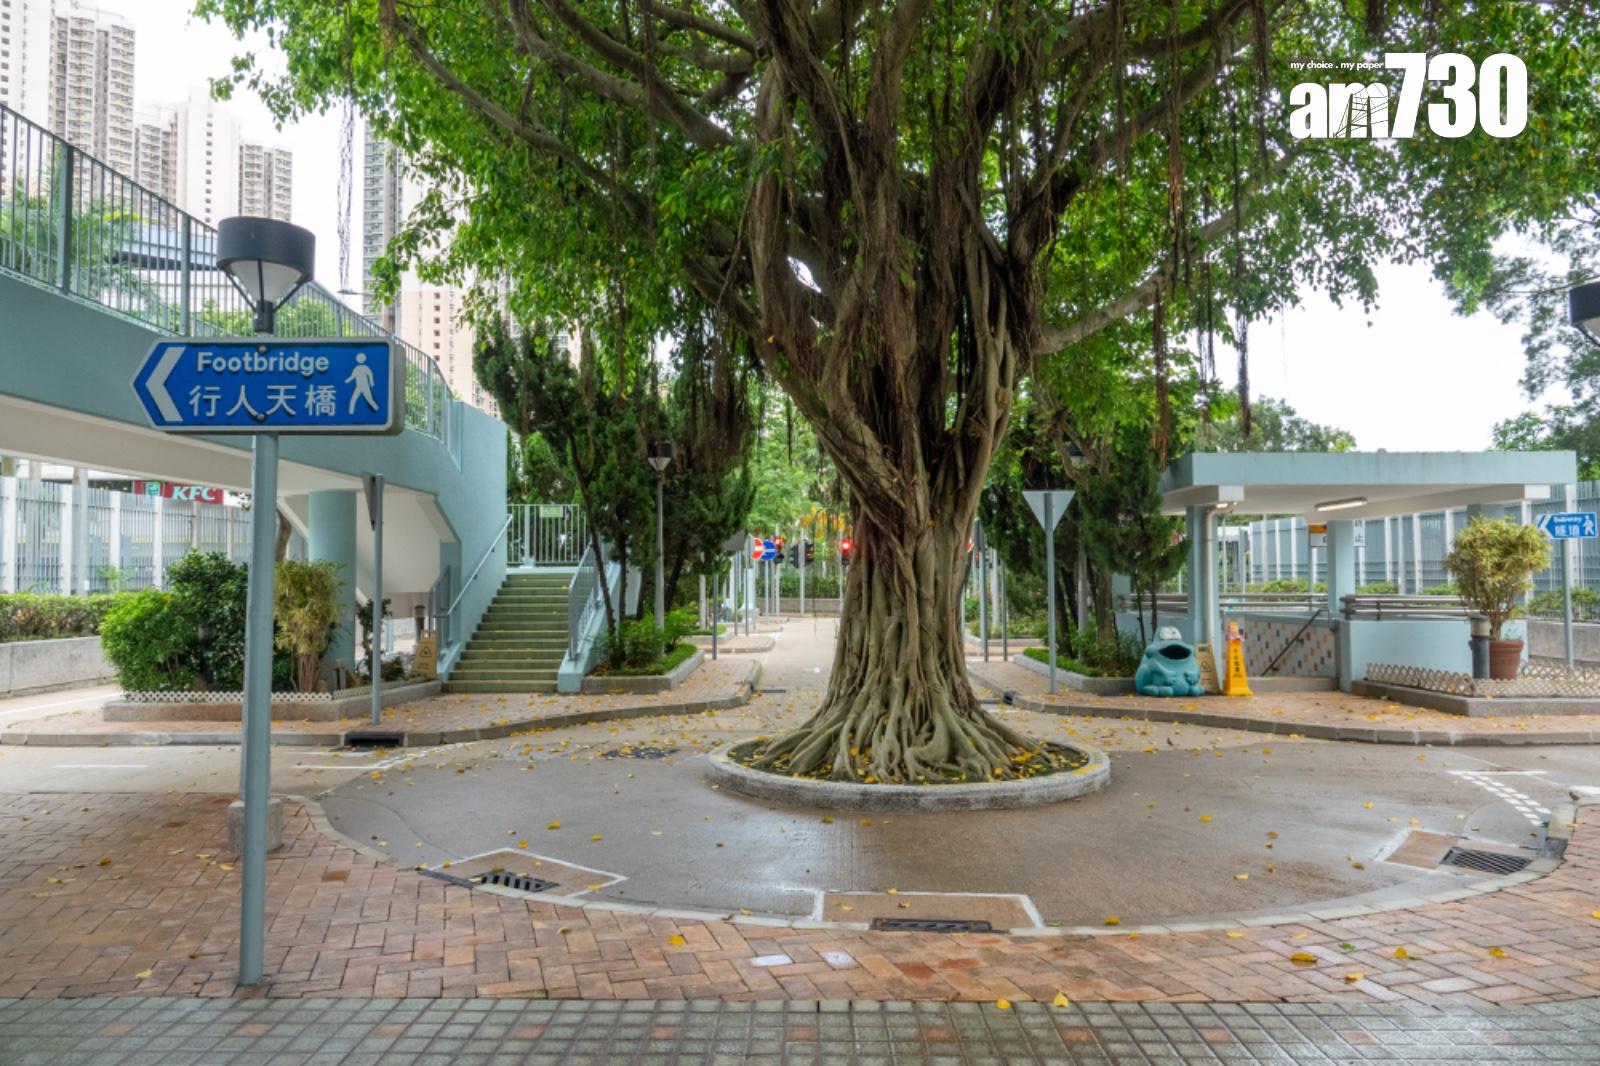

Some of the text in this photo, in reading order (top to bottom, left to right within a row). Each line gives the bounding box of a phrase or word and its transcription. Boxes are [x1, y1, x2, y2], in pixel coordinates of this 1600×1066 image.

[197, 351, 329, 375] Footbridge
[188, 384, 337, 417] 行人天橋
[172, 486, 215, 501] KFC
